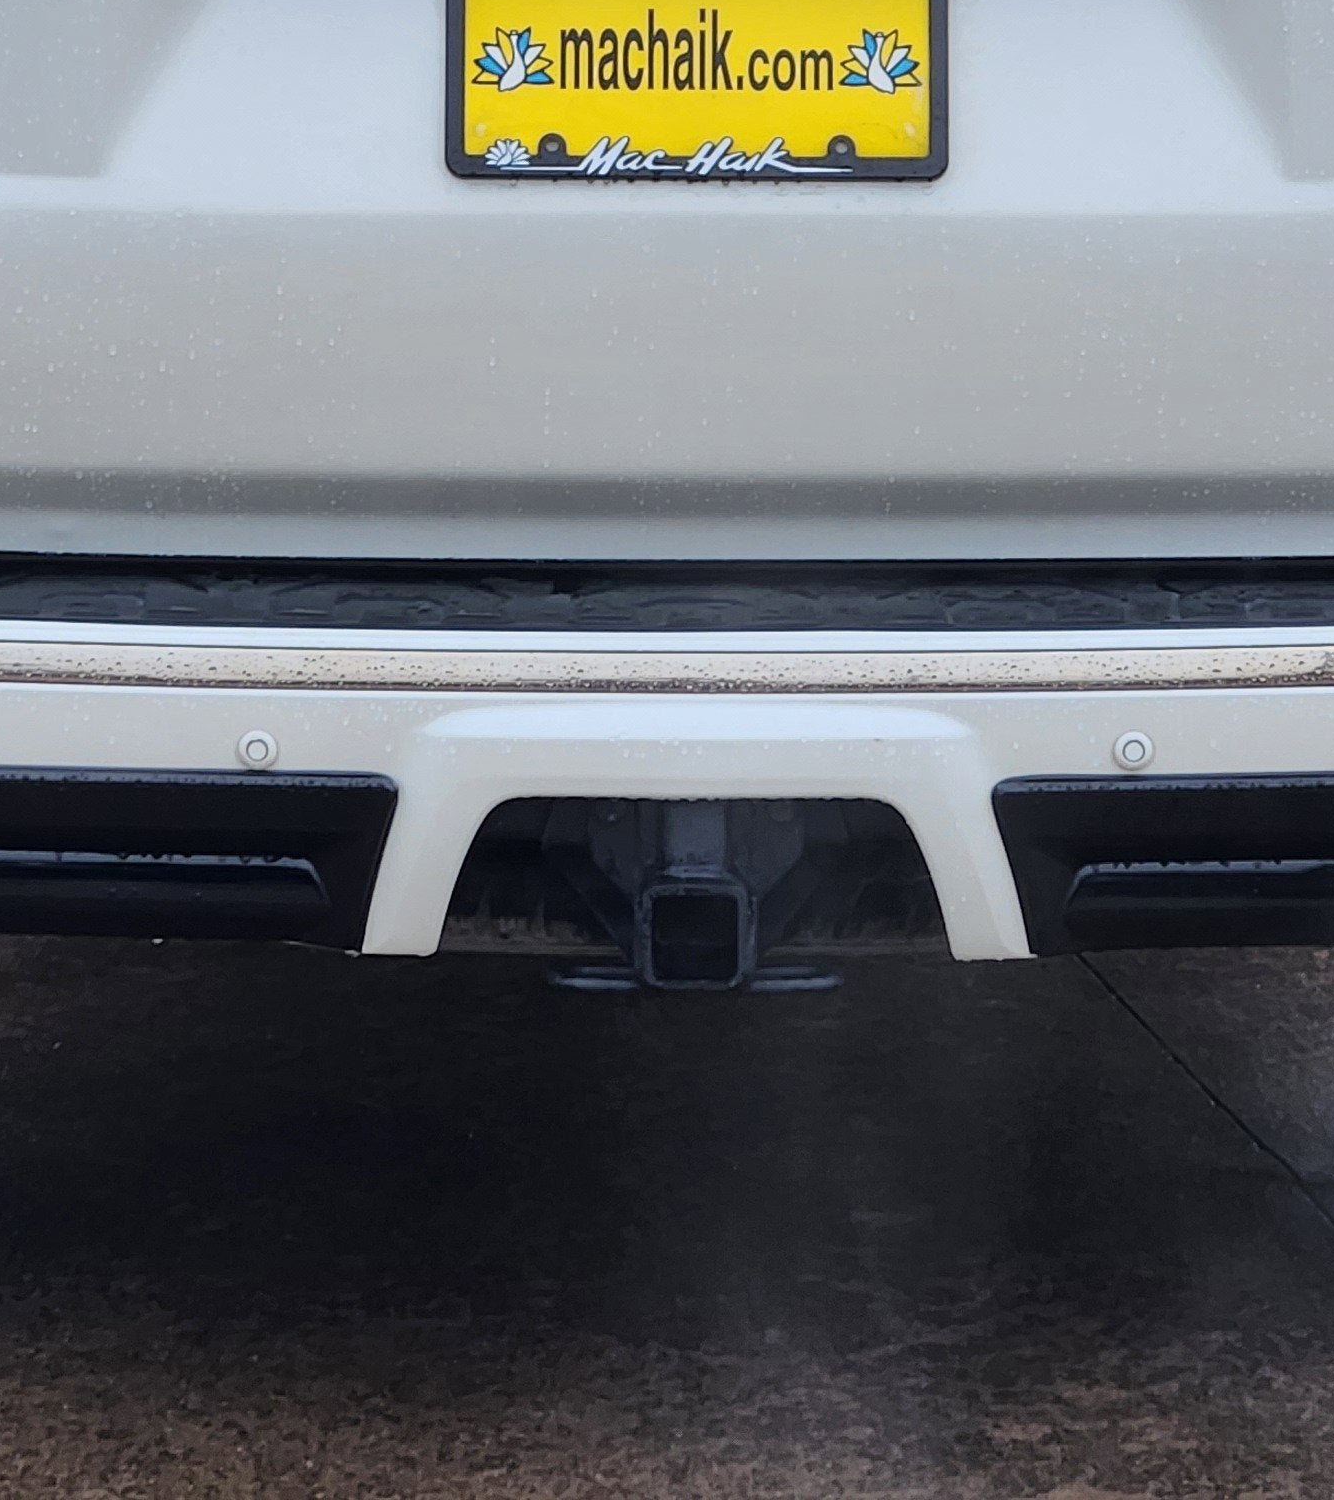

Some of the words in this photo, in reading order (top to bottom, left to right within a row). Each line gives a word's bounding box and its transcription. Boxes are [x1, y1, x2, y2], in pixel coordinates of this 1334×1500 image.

[559, 8, 834, 91] machaik.com
[575, 136, 681, 175] Mac
[684, 136, 795, 176] Haik
